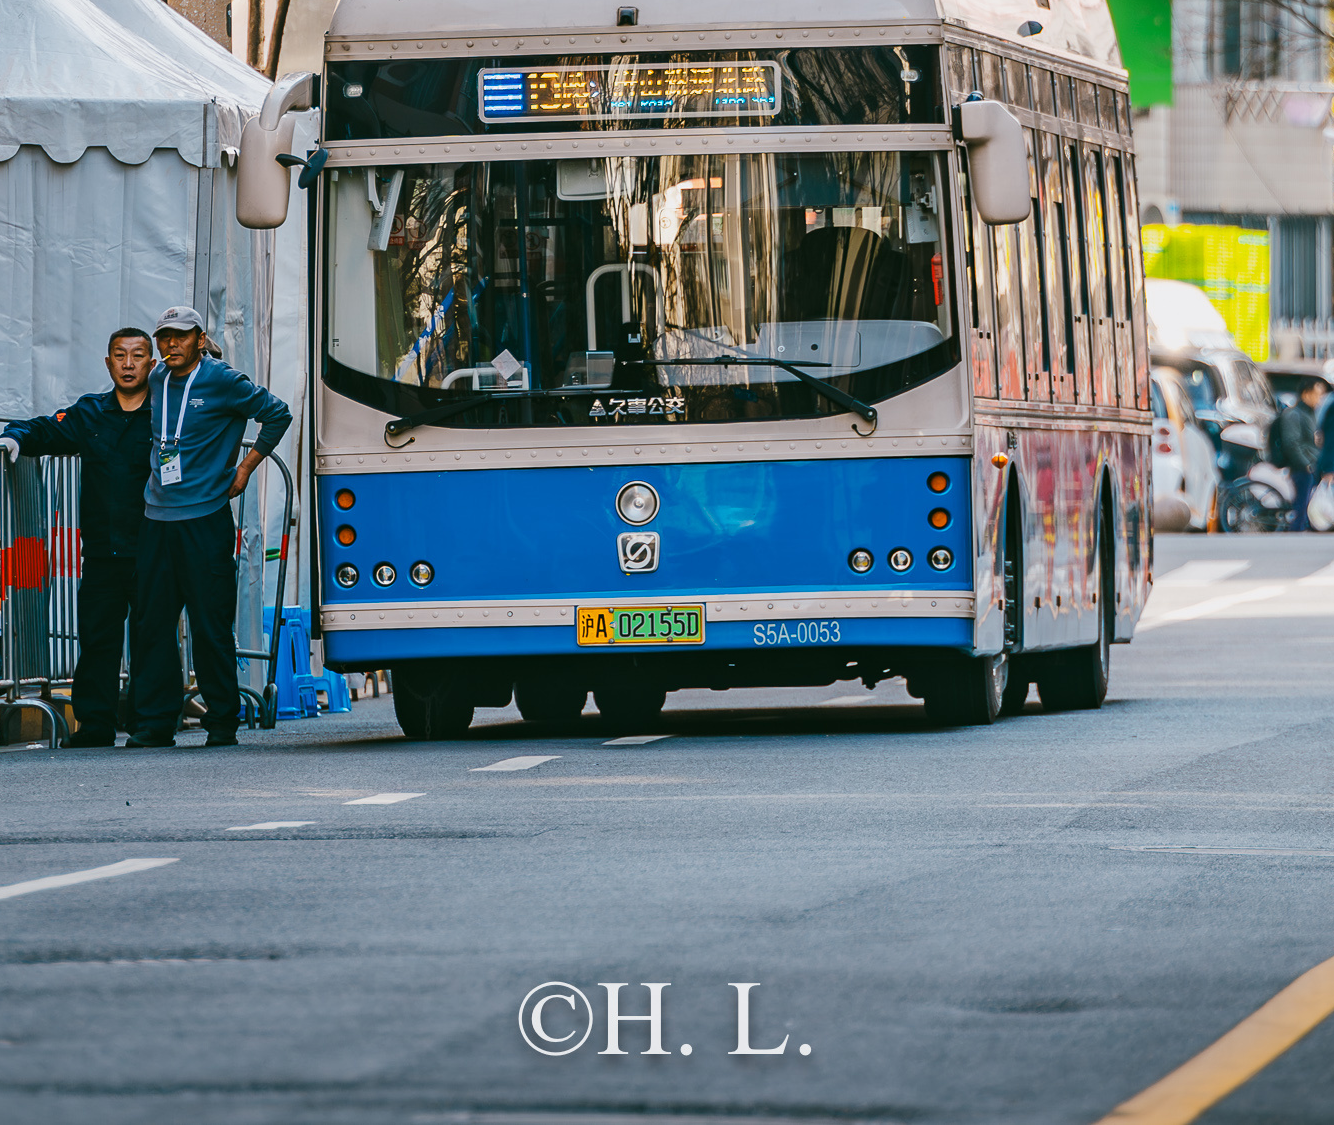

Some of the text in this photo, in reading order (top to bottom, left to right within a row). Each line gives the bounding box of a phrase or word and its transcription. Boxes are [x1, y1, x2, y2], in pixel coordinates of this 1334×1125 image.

[608, 397, 685, 415] 久事公交
[753, 621, 841, 646] S5A-0053
